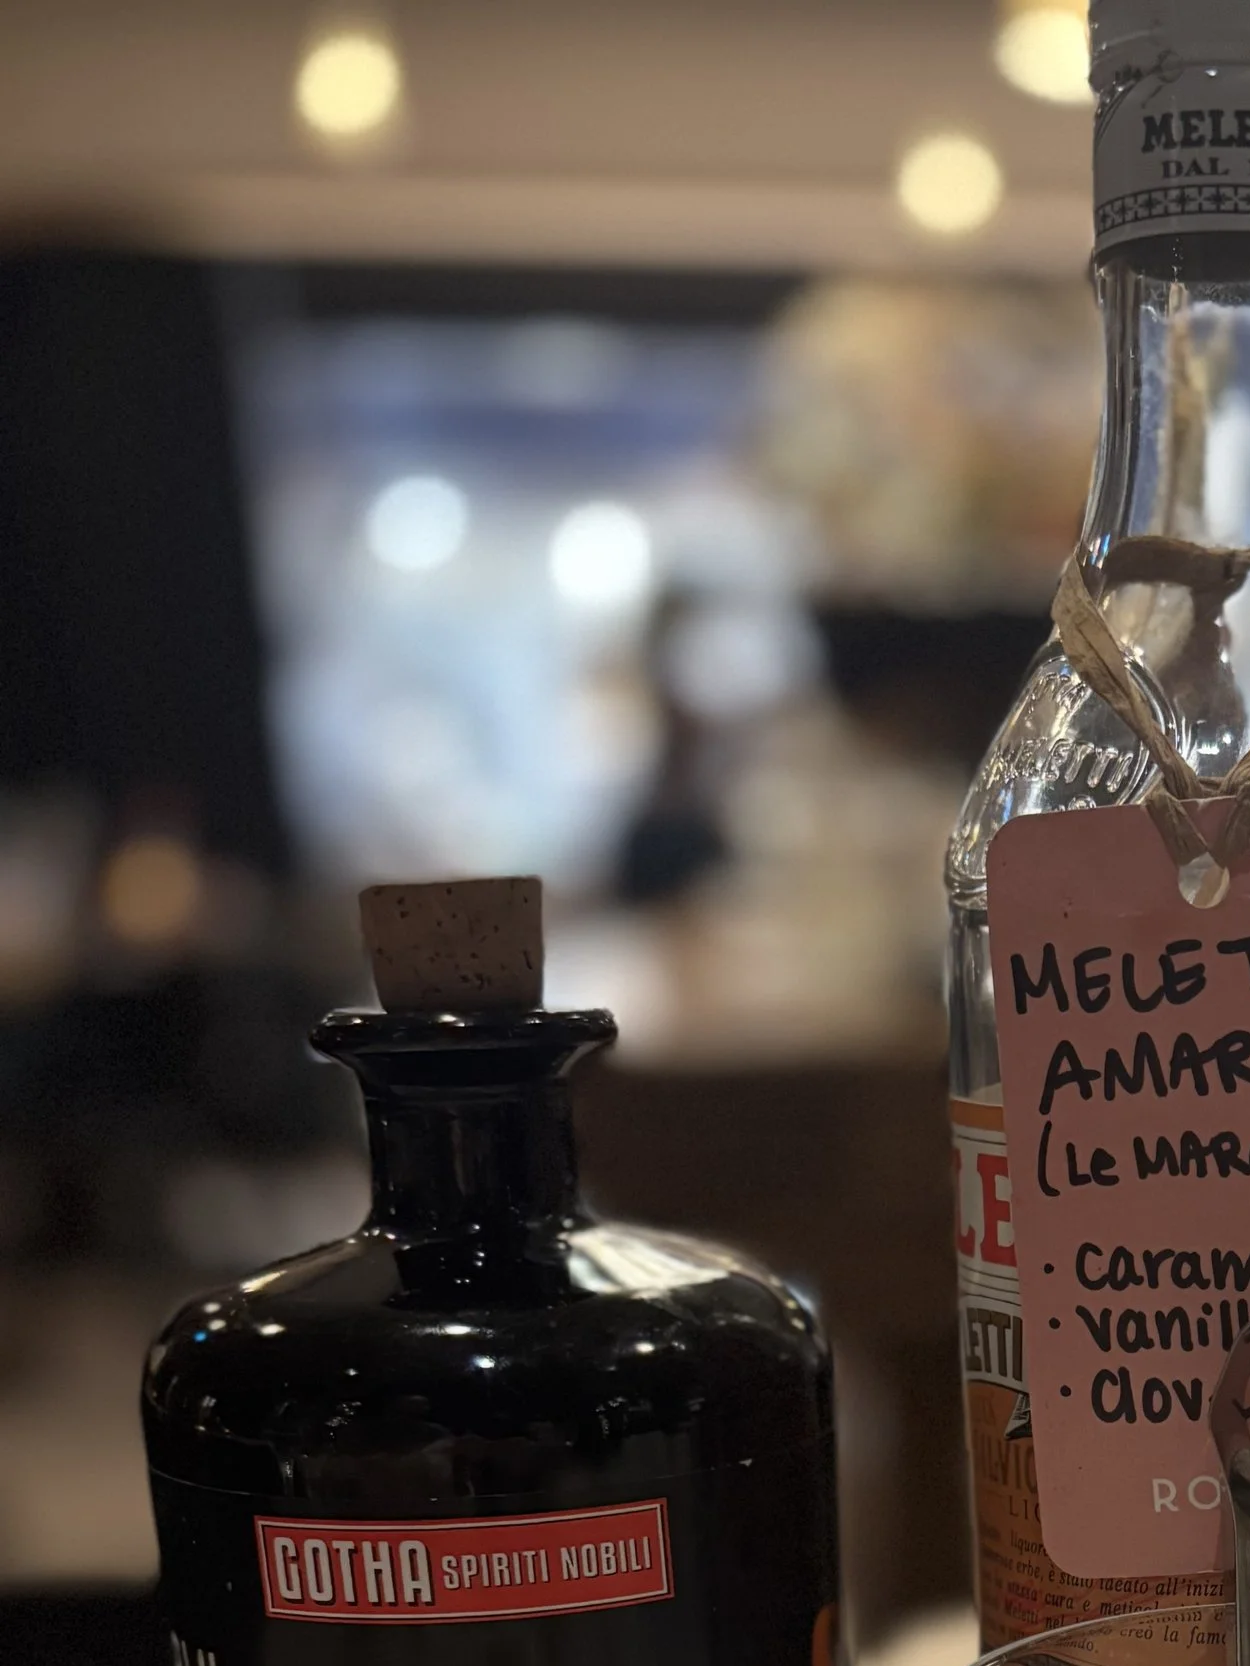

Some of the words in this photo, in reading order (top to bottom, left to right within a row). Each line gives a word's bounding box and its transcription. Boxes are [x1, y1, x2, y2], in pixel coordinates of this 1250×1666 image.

[1162, 157, 1229, 179] DAL
[273, 1535, 435, 1606] GOTHA
[441, 1549, 549, 1590] SPIRITI
[560, 1536, 652, 1581] NOBILI
[1154, 1575, 1224, 1598] all'inizi
